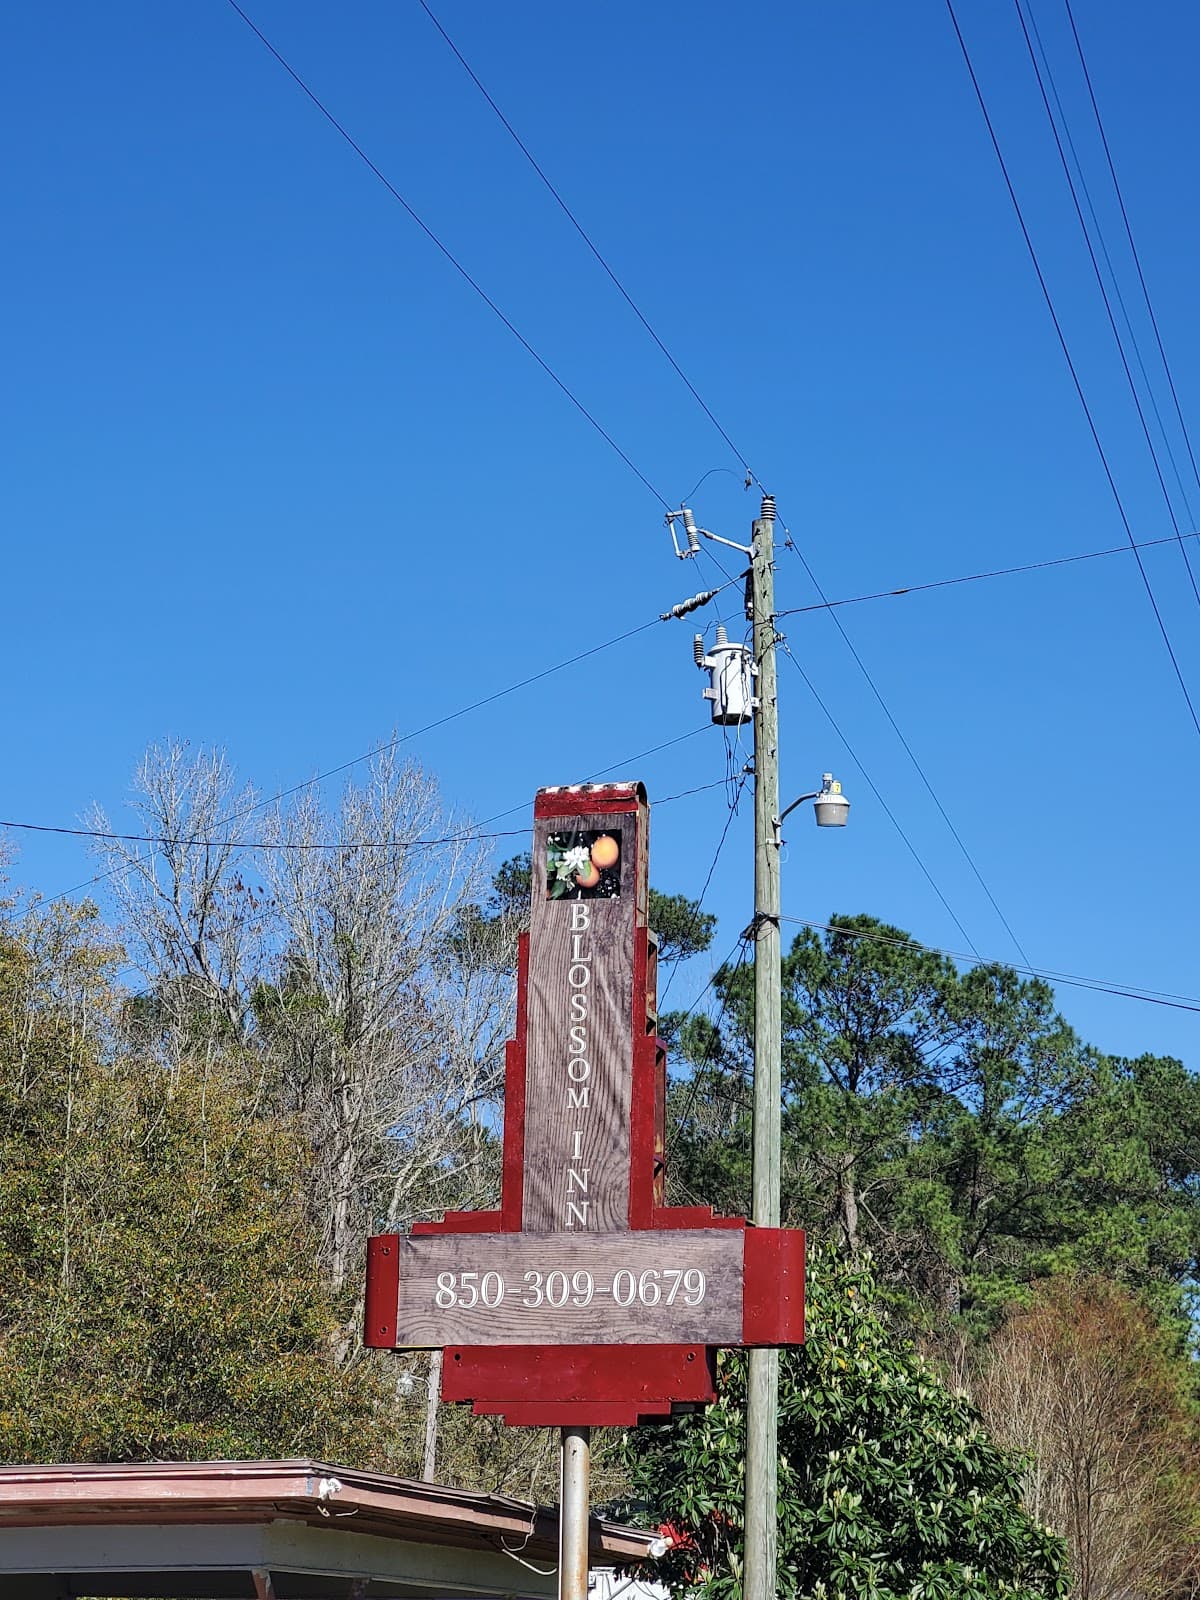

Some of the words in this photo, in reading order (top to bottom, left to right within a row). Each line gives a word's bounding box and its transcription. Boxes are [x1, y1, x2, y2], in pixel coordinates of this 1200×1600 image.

[566, 903, 592, 1109] BLOSSOM
[565, 1130, 591, 1226] INN
[435, 1268, 706, 1309] 850-309-0679
